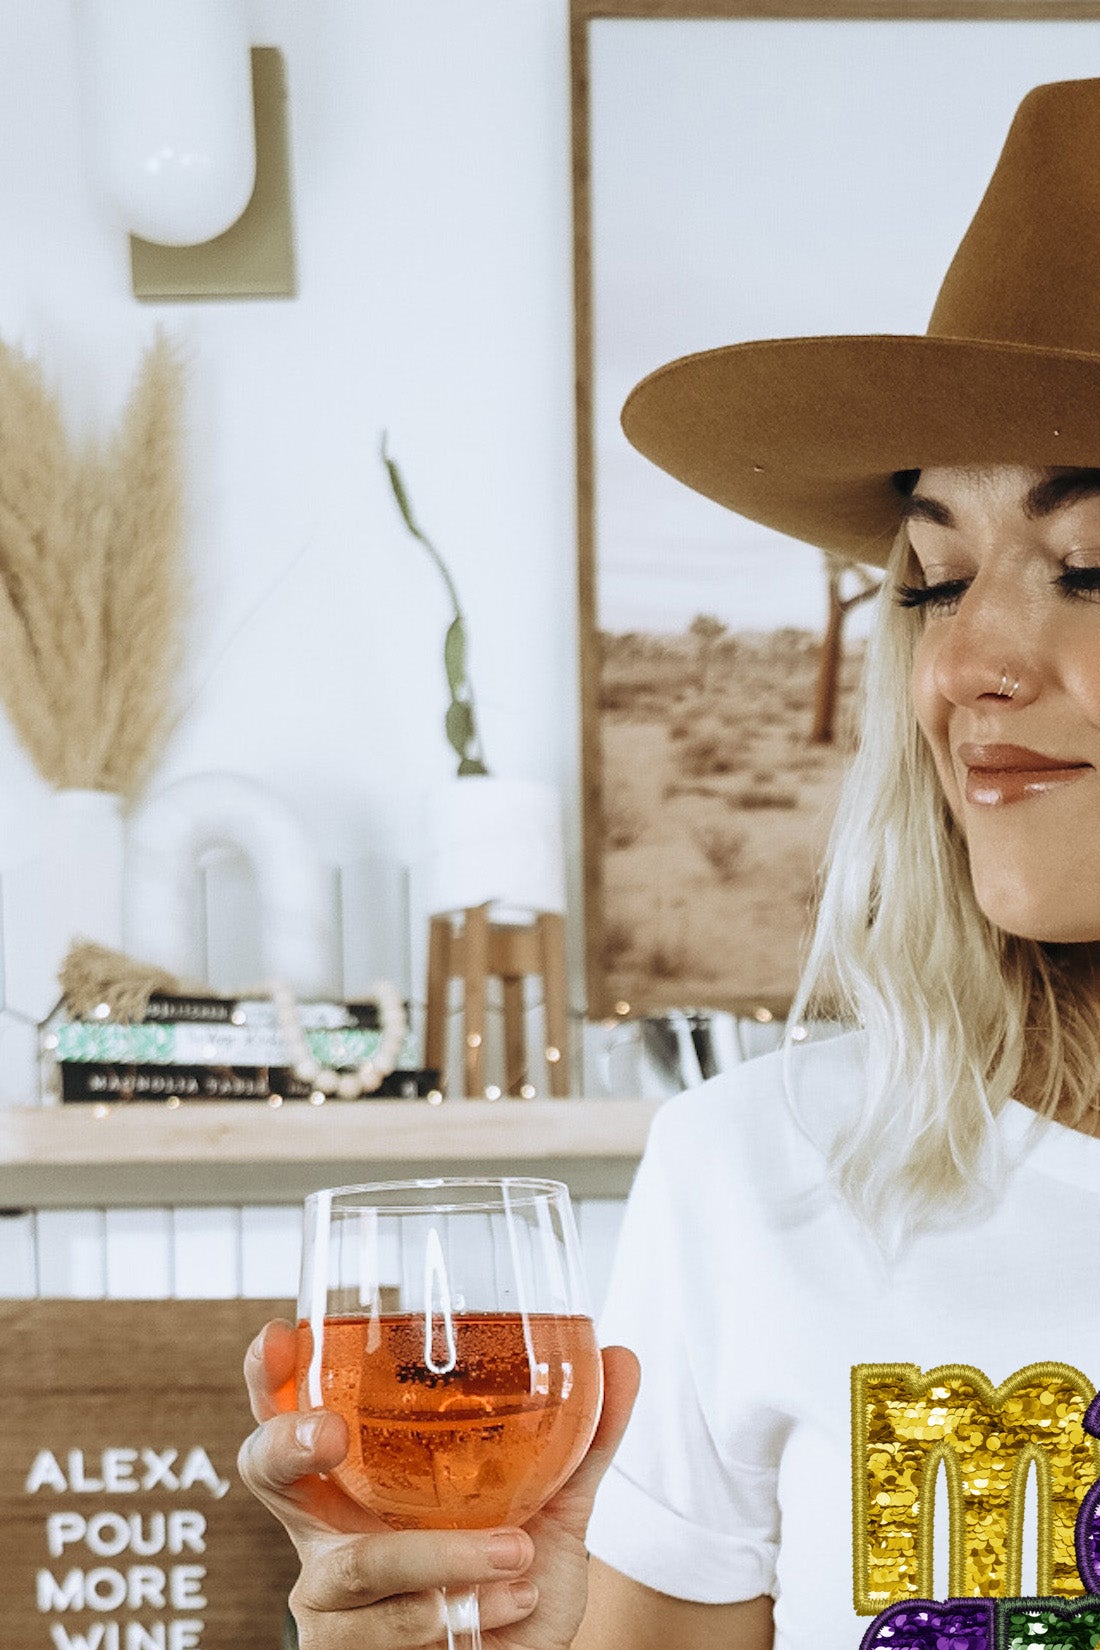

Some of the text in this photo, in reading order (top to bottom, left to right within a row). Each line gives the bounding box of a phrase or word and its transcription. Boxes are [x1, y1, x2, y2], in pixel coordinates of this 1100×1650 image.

[25, 1446, 230, 1499] ALEXA,
[47, 1511, 207, 1557] POUR
[36, 1564, 208, 1612] MORE
